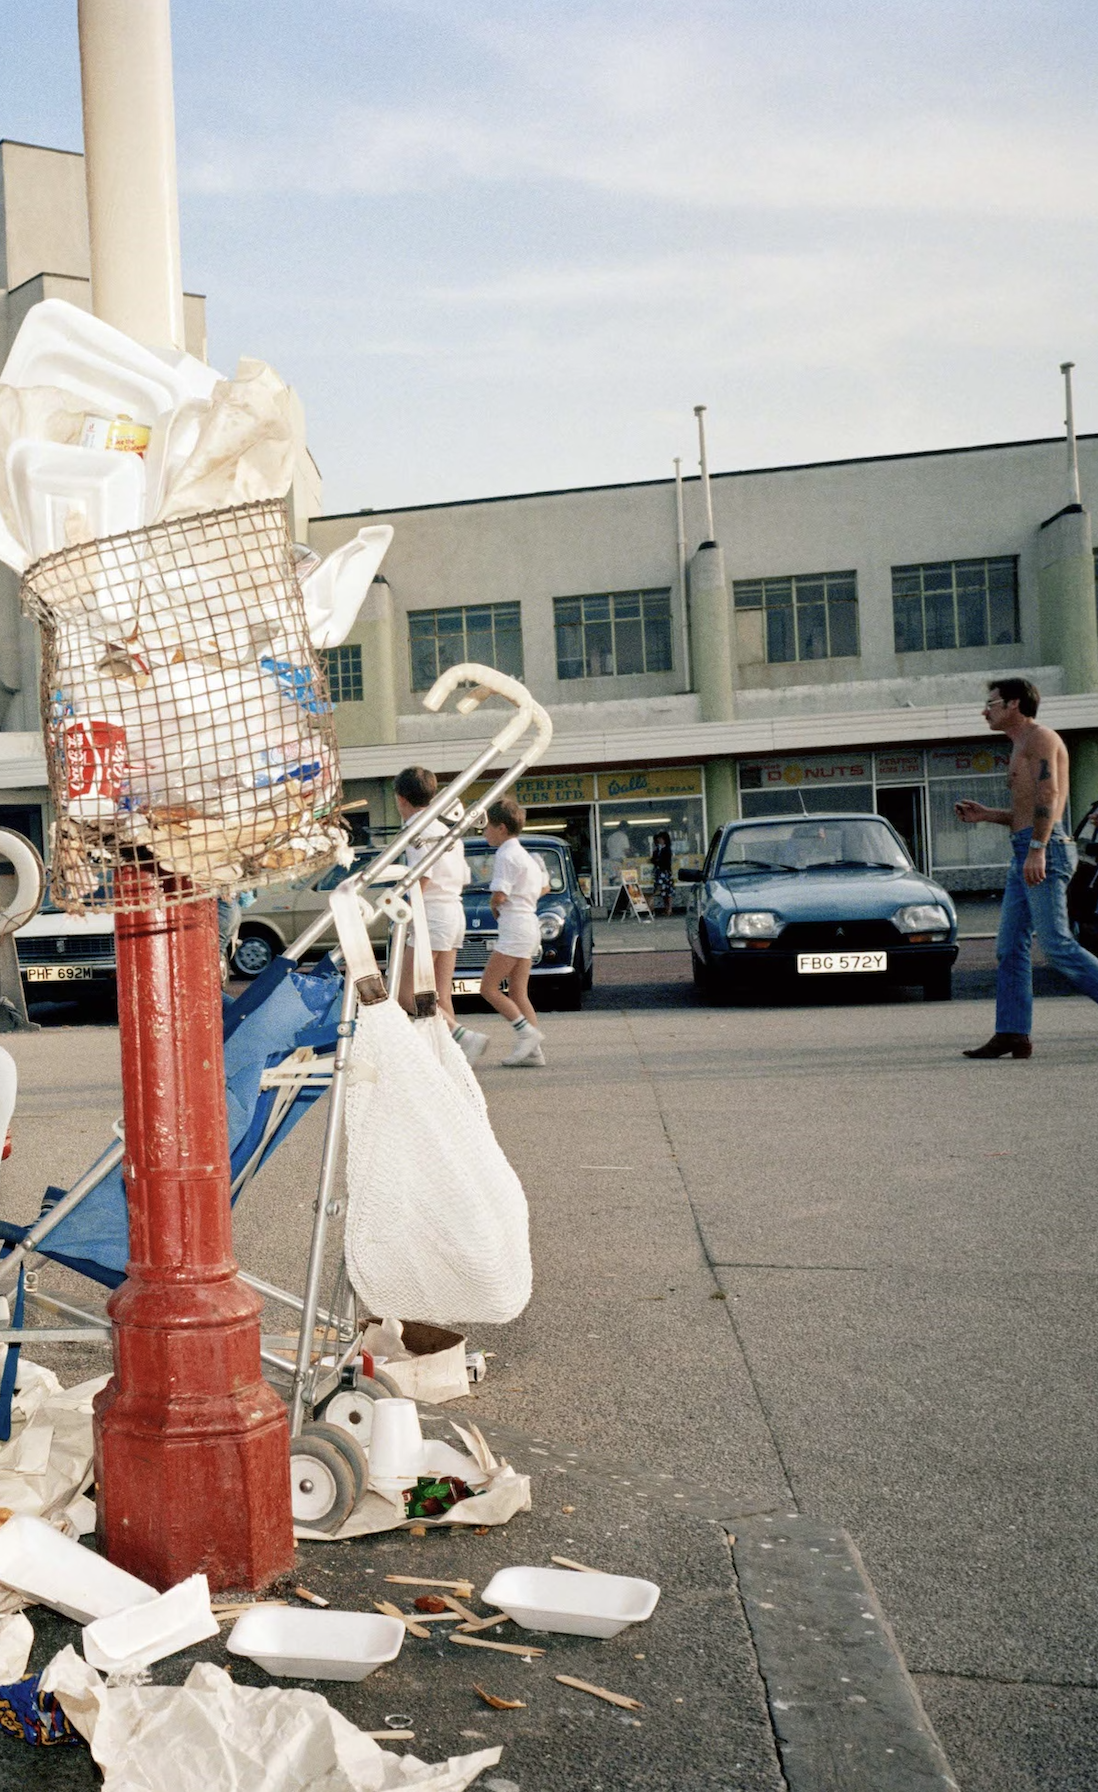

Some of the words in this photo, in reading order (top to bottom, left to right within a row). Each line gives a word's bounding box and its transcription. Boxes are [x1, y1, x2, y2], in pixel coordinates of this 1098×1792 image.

[767, 763, 864, 785] DONUTS
[515, 778, 583, 792] PERFECT
[516, 791, 549, 803] ICES
[800, 956, 833, 970] FBG
[839, 955, 884, 969] 572Y
[28, 968, 53, 980] PHF
[57, 967, 92, 979] 692M
